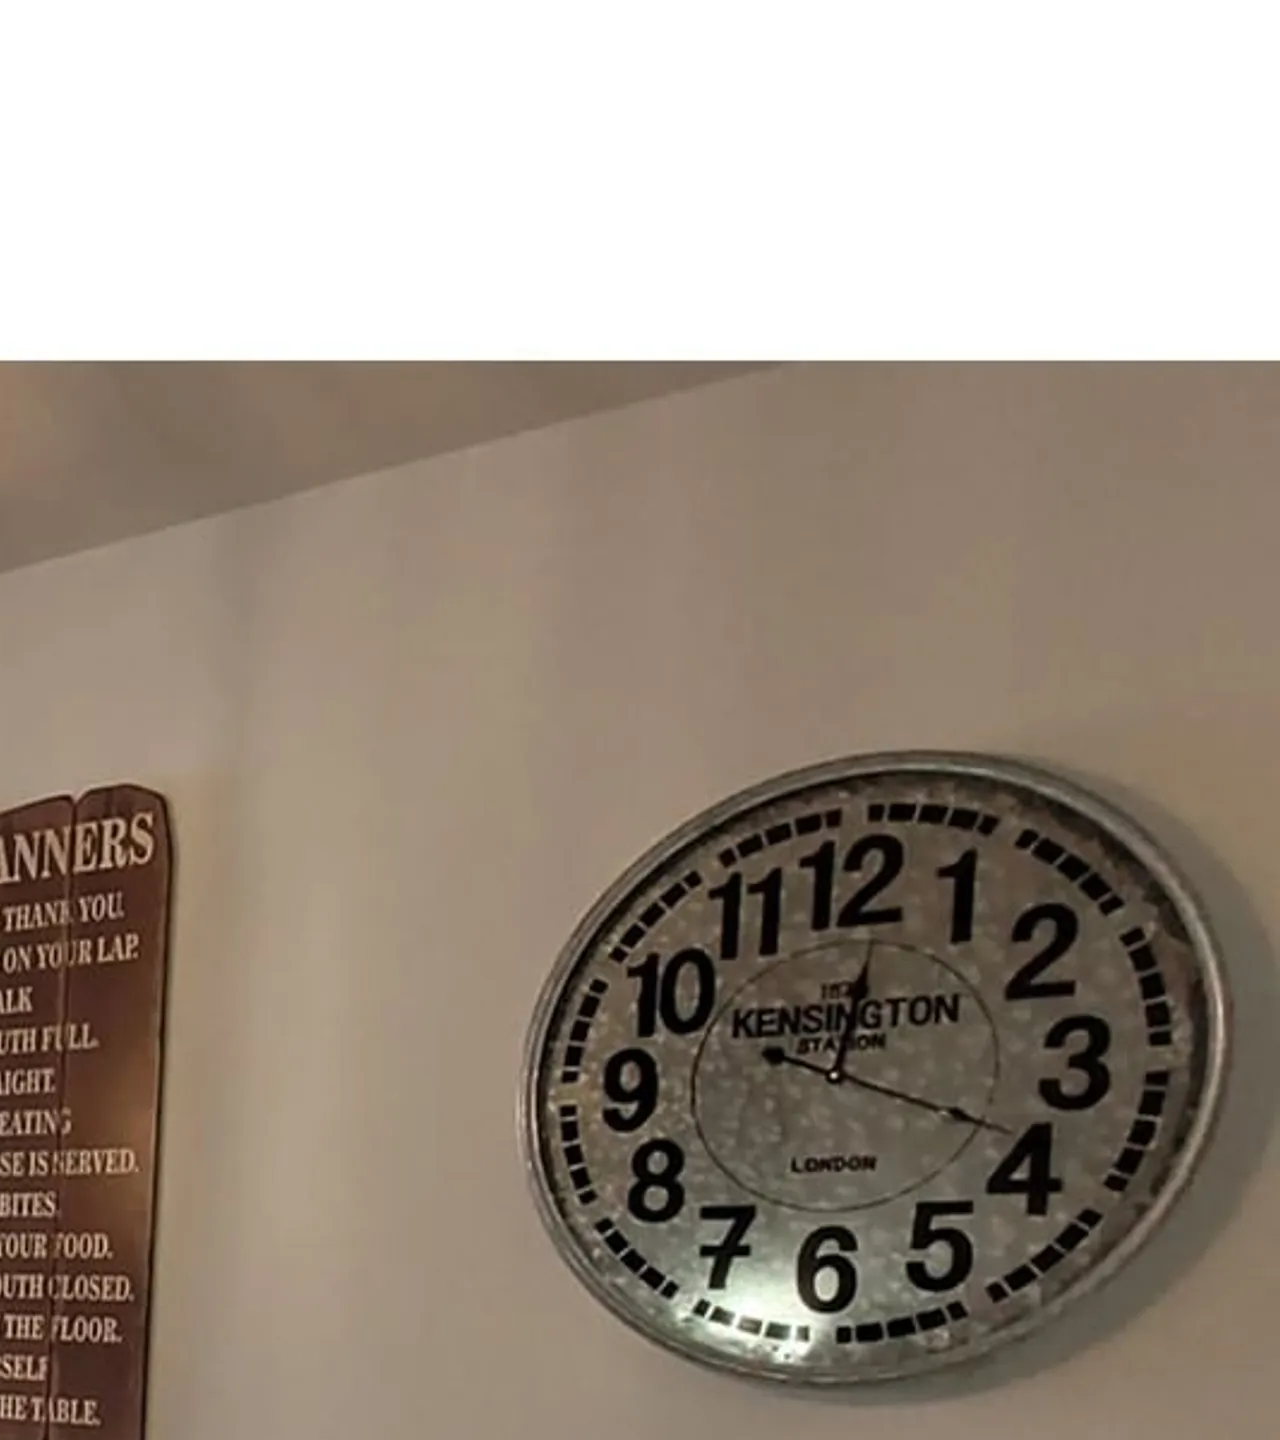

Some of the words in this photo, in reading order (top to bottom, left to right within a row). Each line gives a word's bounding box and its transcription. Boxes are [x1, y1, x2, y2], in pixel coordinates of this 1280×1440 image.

[709, 868, 782, 960] 11
[799, 834, 905, 929] 12
[936, 848, 978, 943] 1
[2, 947, 32, 975] ON
[36, 940, 92, 971] YOUR
[628, 947, 715, 1037] 10
[1004, 902, 1079, 1000] 2
[732, 993, 960, 1038] KENSINGTON
[602, 1048, 659, 1132] 9
[1039, 1015, 1111, 1111] 3
[28, 1150, 50, 1177] IS
[626, 1139, 685, 1223] 8
[791, 1156, 877, 1173] LONDON
[986, 1122, 1063, 1215] 4
[698, 1204, 757, 1289] 7
[796, 1226, 859, 1313] 6
[906, 1201, 974, 1291] 5
[2, 1314, 44, 1340] THE
